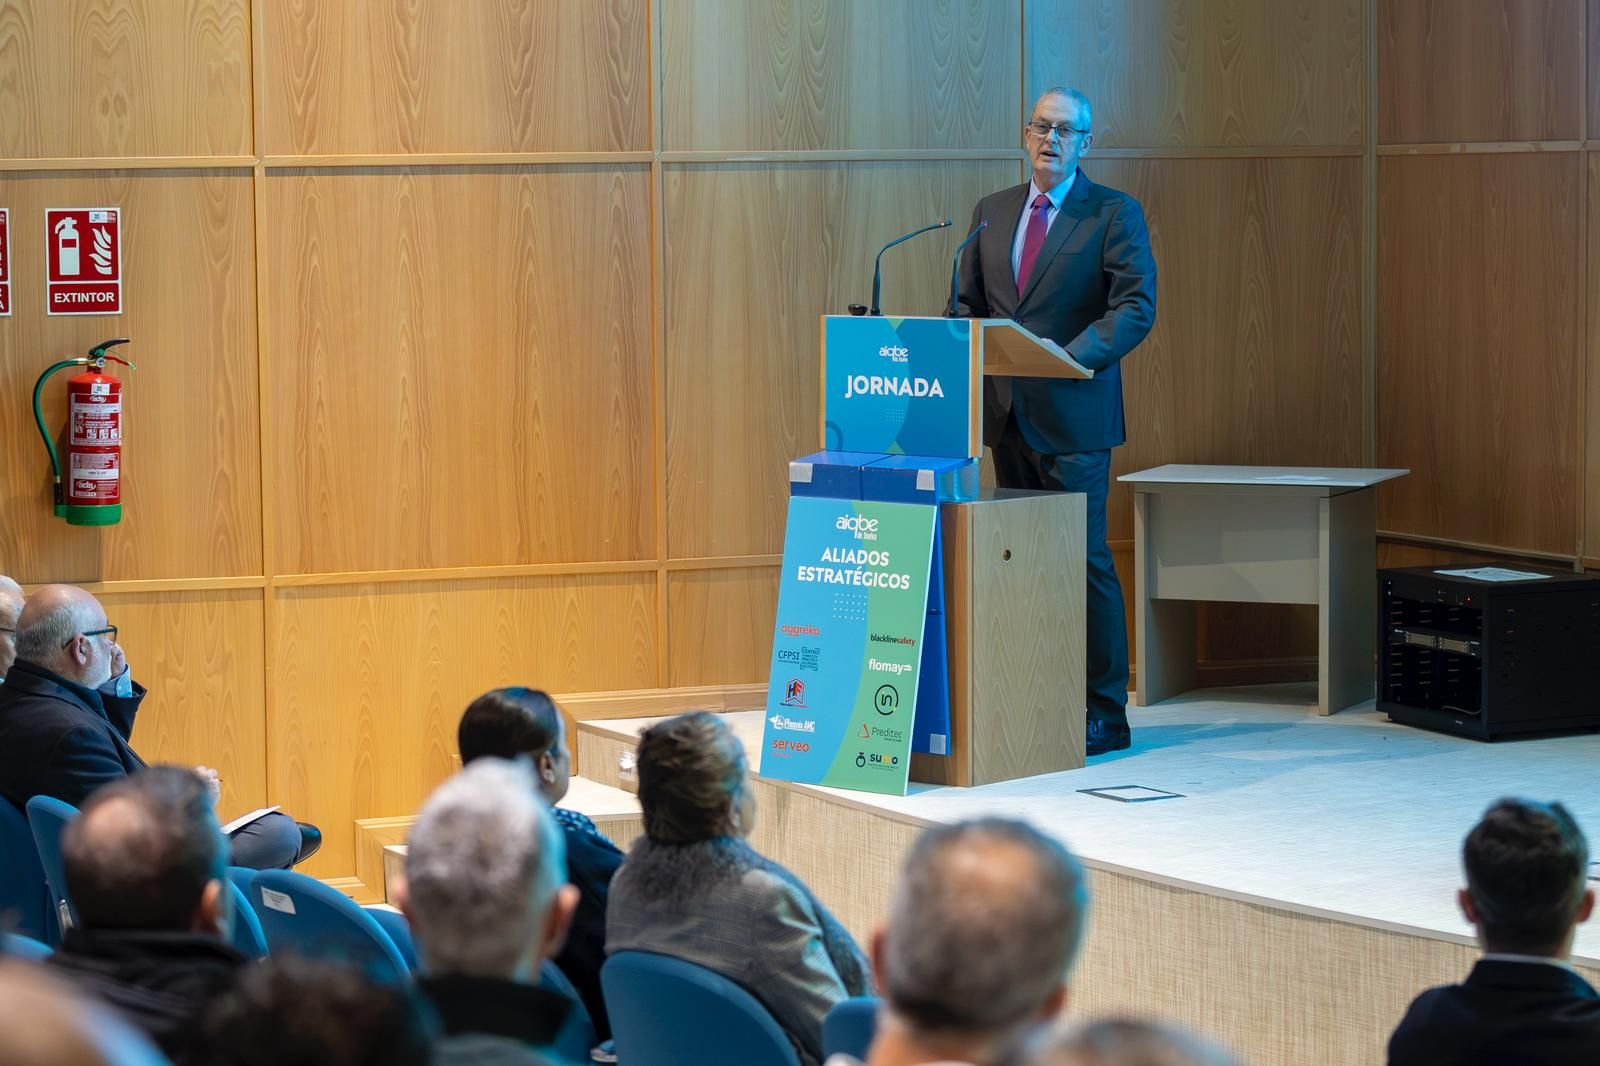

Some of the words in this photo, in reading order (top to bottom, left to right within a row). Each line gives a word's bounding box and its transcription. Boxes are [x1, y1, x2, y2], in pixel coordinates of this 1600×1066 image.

[54, 292, 115, 303] EXTINTOR
[845, 375, 944, 398] JORNADA
[821, 547, 890, 567] ALIADOS
[797, 566, 911, 590] ESTRATÉGICOS
[781, 624, 820, 637] aggreko
[870, 633, 916, 647] blacklinesafety
[778, 650, 800, 661] CFPSI
[868, 658, 903, 676] flomay
[872, 727, 903, 739] Preditec
[772, 739, 810, 753] serveo
